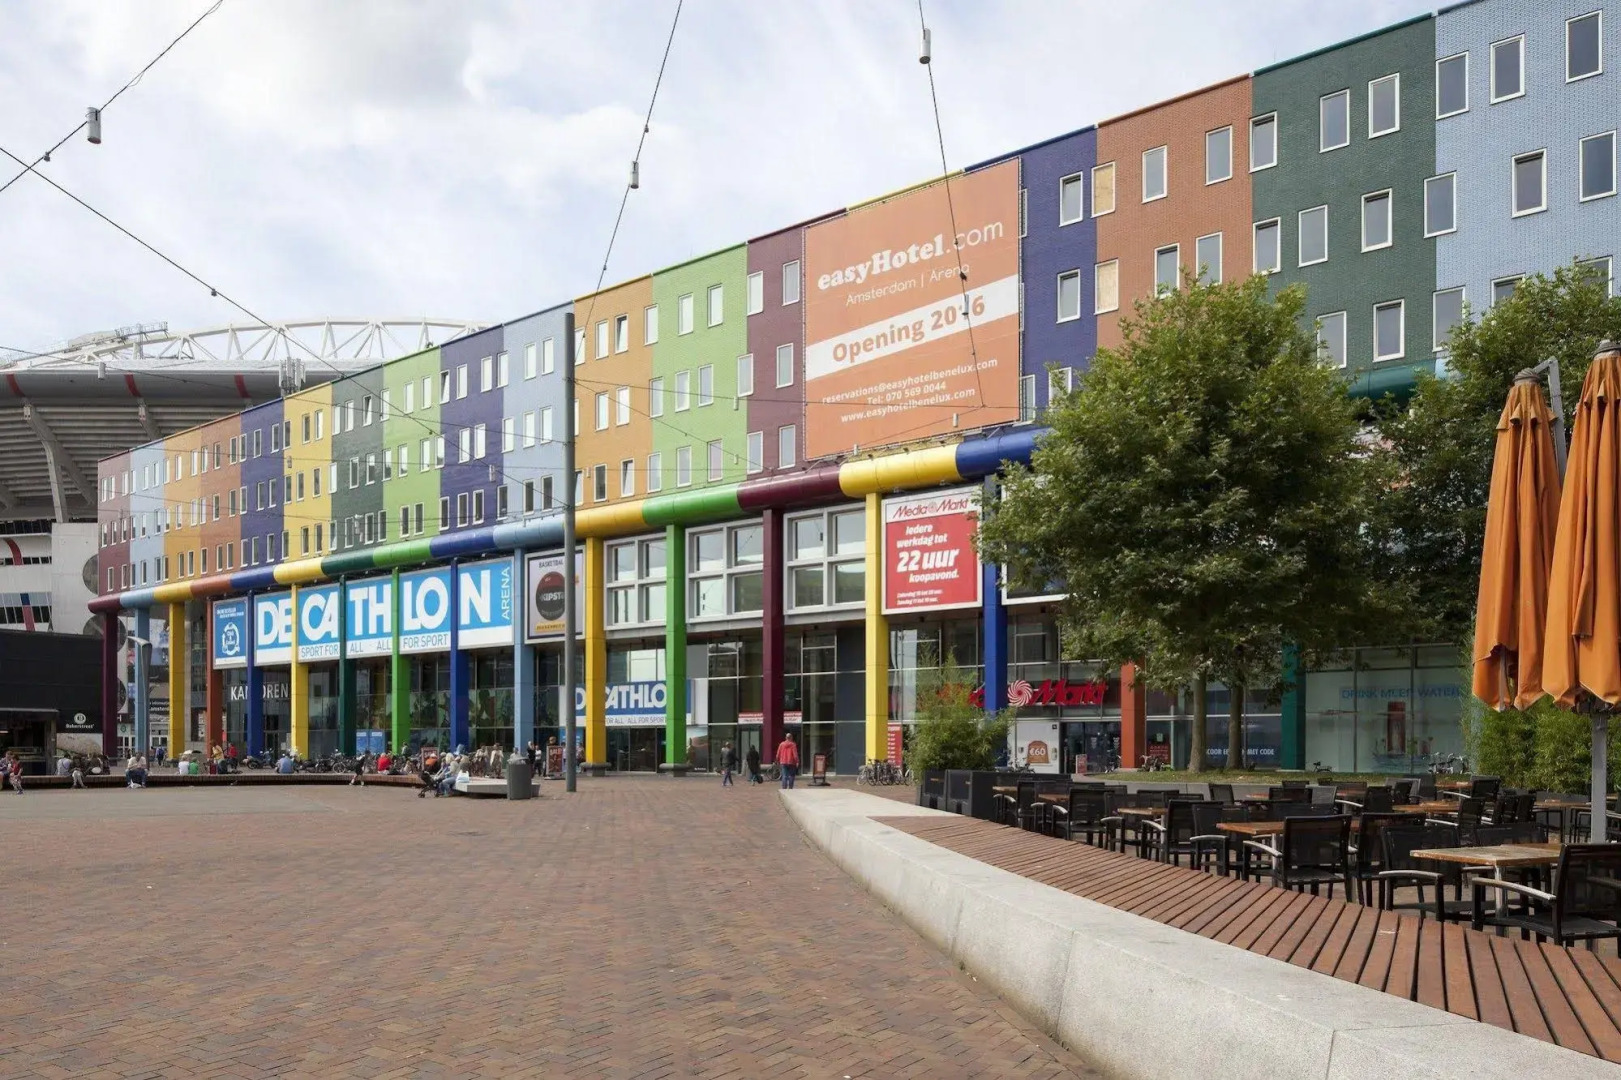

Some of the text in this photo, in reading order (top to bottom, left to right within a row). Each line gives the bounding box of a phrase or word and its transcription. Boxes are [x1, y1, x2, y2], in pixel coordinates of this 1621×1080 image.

[817, 221, 1003, 290] easyHotel.com
[846, 264, 970, 306] Amsterdam Arena
[832, 295, 985, 363] Opening 206
[867, 381, 946, 406] Tel: 070 569 0044
[893, 498, 968, 519] Media Markt
[896, 534, 948, 548] werkdag tot
[905, 524, 933, 535] Iedere
[896, 549, 960, 572] 22 uur
[908, 569, 960, 583] koopavond.
[501, 566, 511, 620] ARENA
[301, 634, 449, 658] SPORT FOR ALL ALL FOR SPORT
